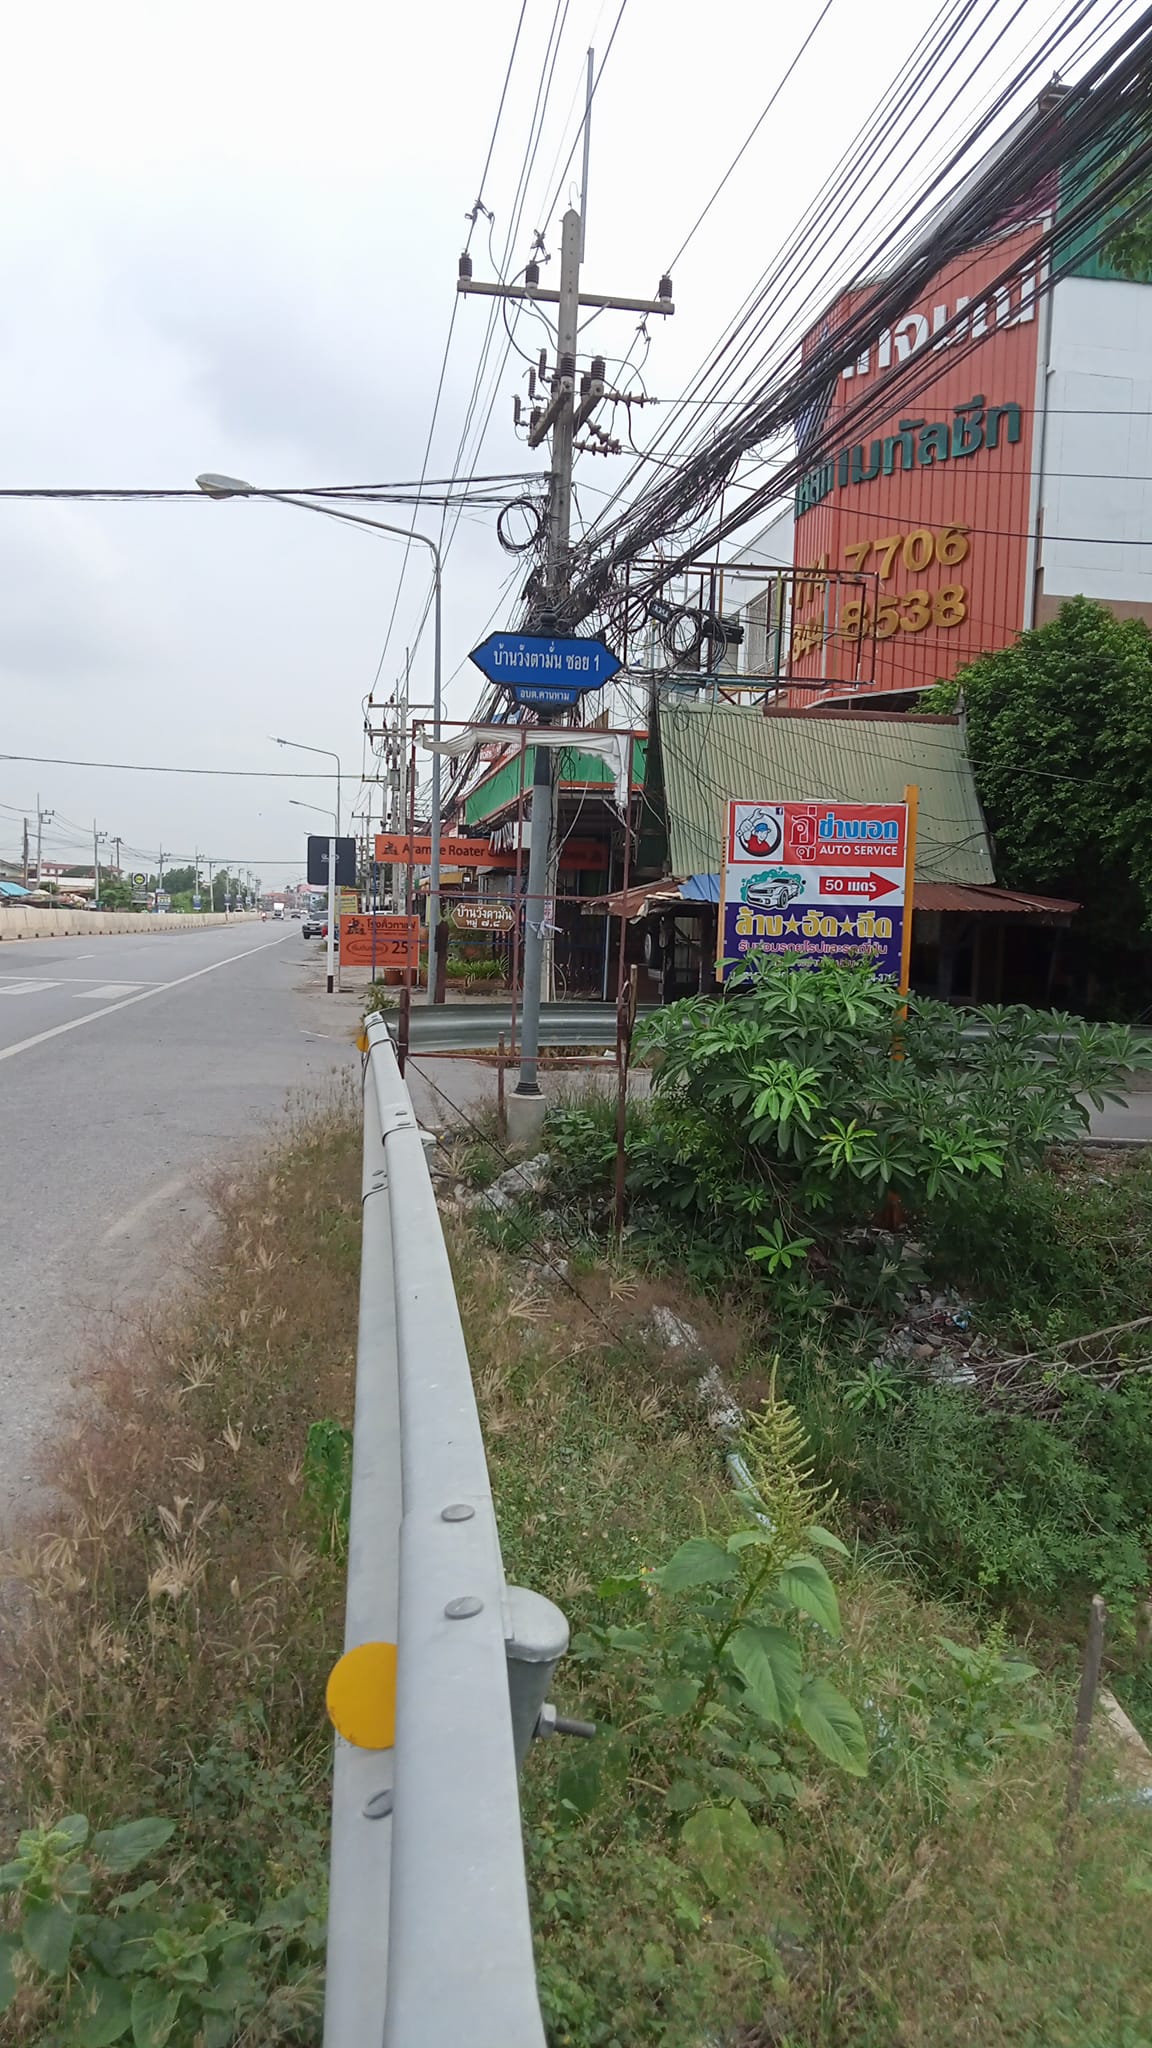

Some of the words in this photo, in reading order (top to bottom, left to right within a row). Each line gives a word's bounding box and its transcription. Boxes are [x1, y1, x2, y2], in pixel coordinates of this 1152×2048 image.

[843, 521, 970, 582] 7706
[840, 584, 968, 642] 8538
[493, 641, 562, 670] บ้านวังตามั่น
[566, 654, 590, 672] ซอย
[593, 655, 600, 672] 1
[819, 845, 851, 856] AUTO
[853, 846, 898, 857] SERVICE
[825, 880, 843, 891] 50
[847, 881, 877, 893] เมตร
[735, 906, 783, 937] ล้าง
[801, 909, 838, 937] อัด
[856, 909, 893, 939] ฉีด
